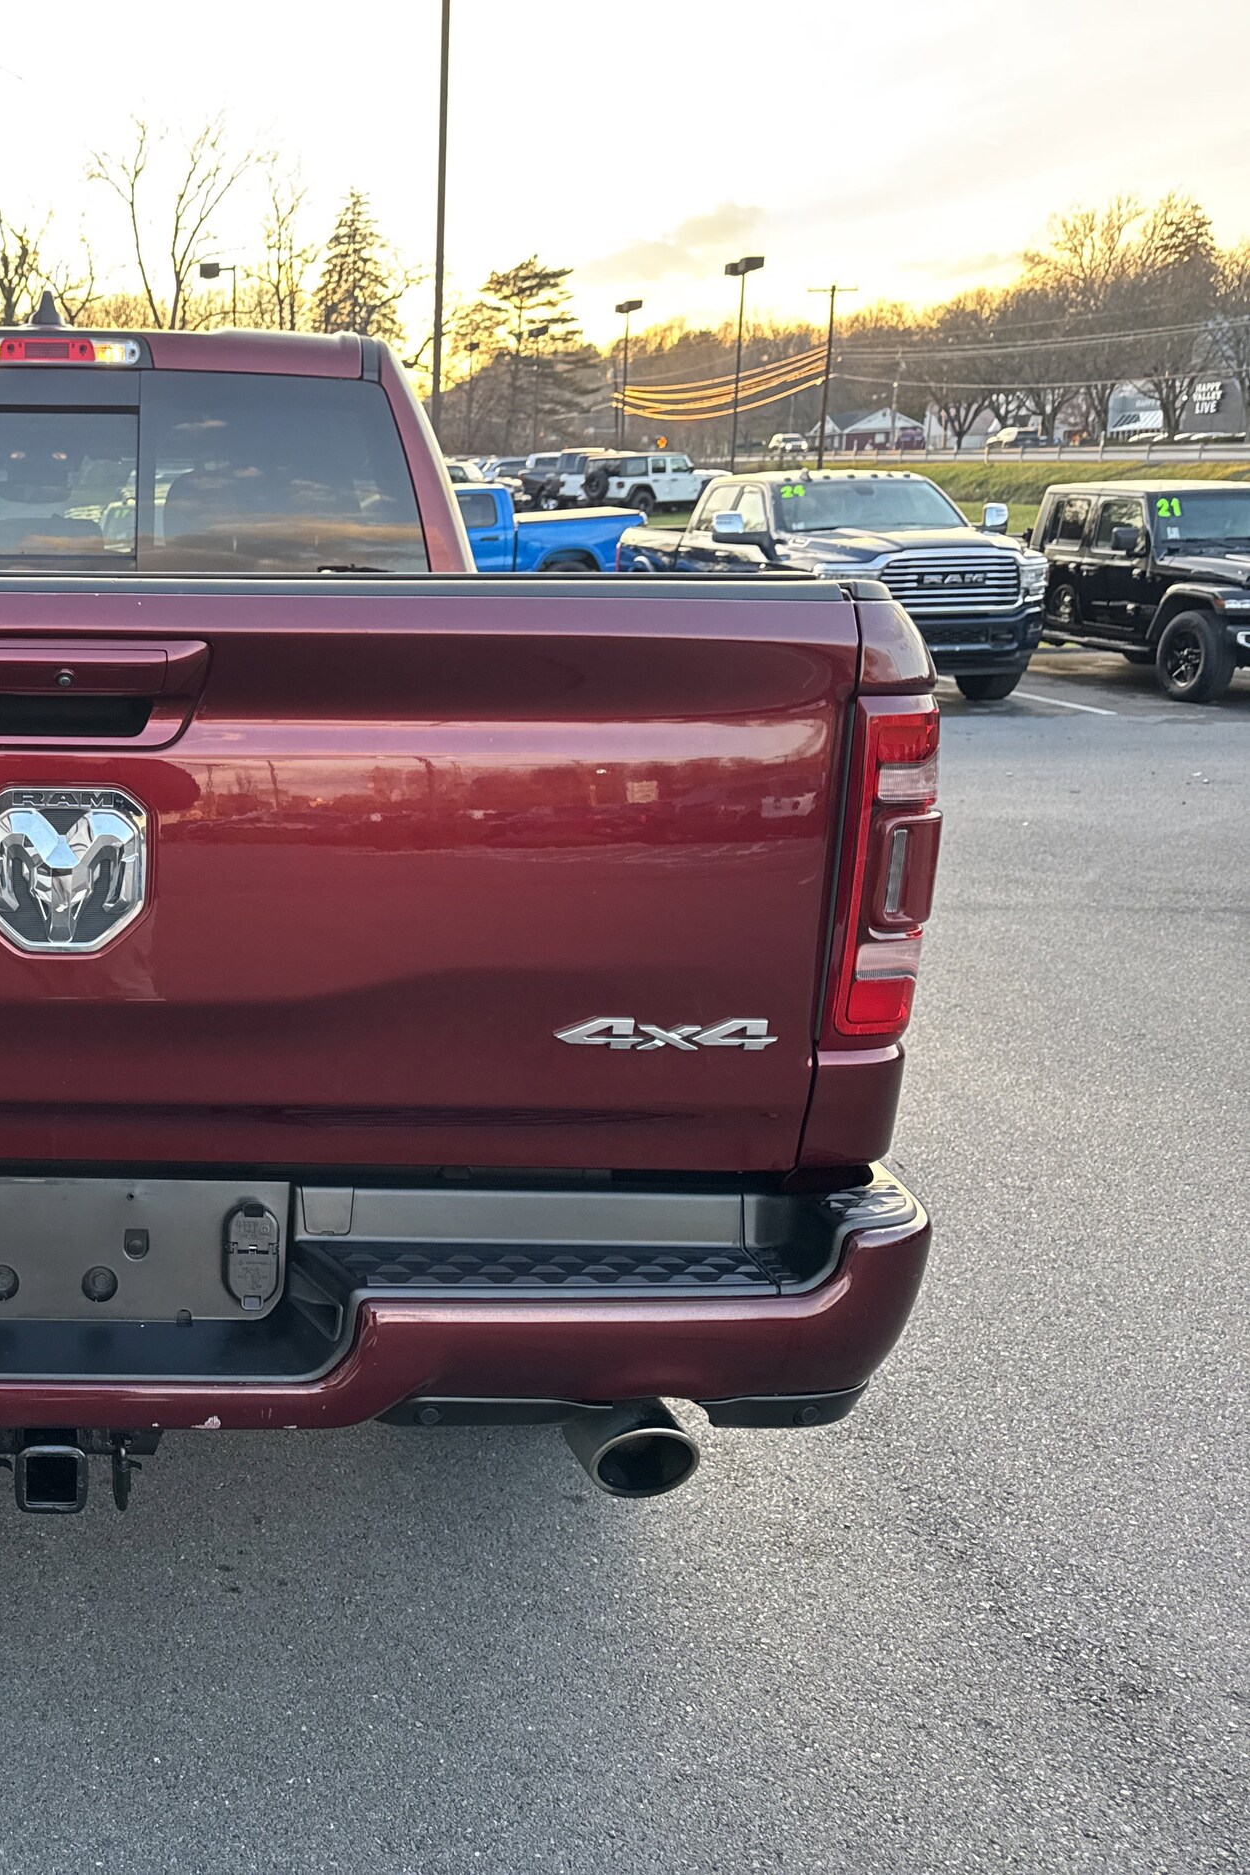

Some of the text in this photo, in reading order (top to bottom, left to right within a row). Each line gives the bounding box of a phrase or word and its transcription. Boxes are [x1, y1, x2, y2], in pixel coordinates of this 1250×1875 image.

[1195, 381, 1222, 392] HAPPY
[1192, 390, 1223, 402] VALLEY
[1195, 400, 1218, 414] LIVE
[1156, 497, 1182, 517] 21
[923, 573, 985, 584] RAM
[11, 791, 114, 808] RAM
[553, 1016, 779, 1050] 4x4
